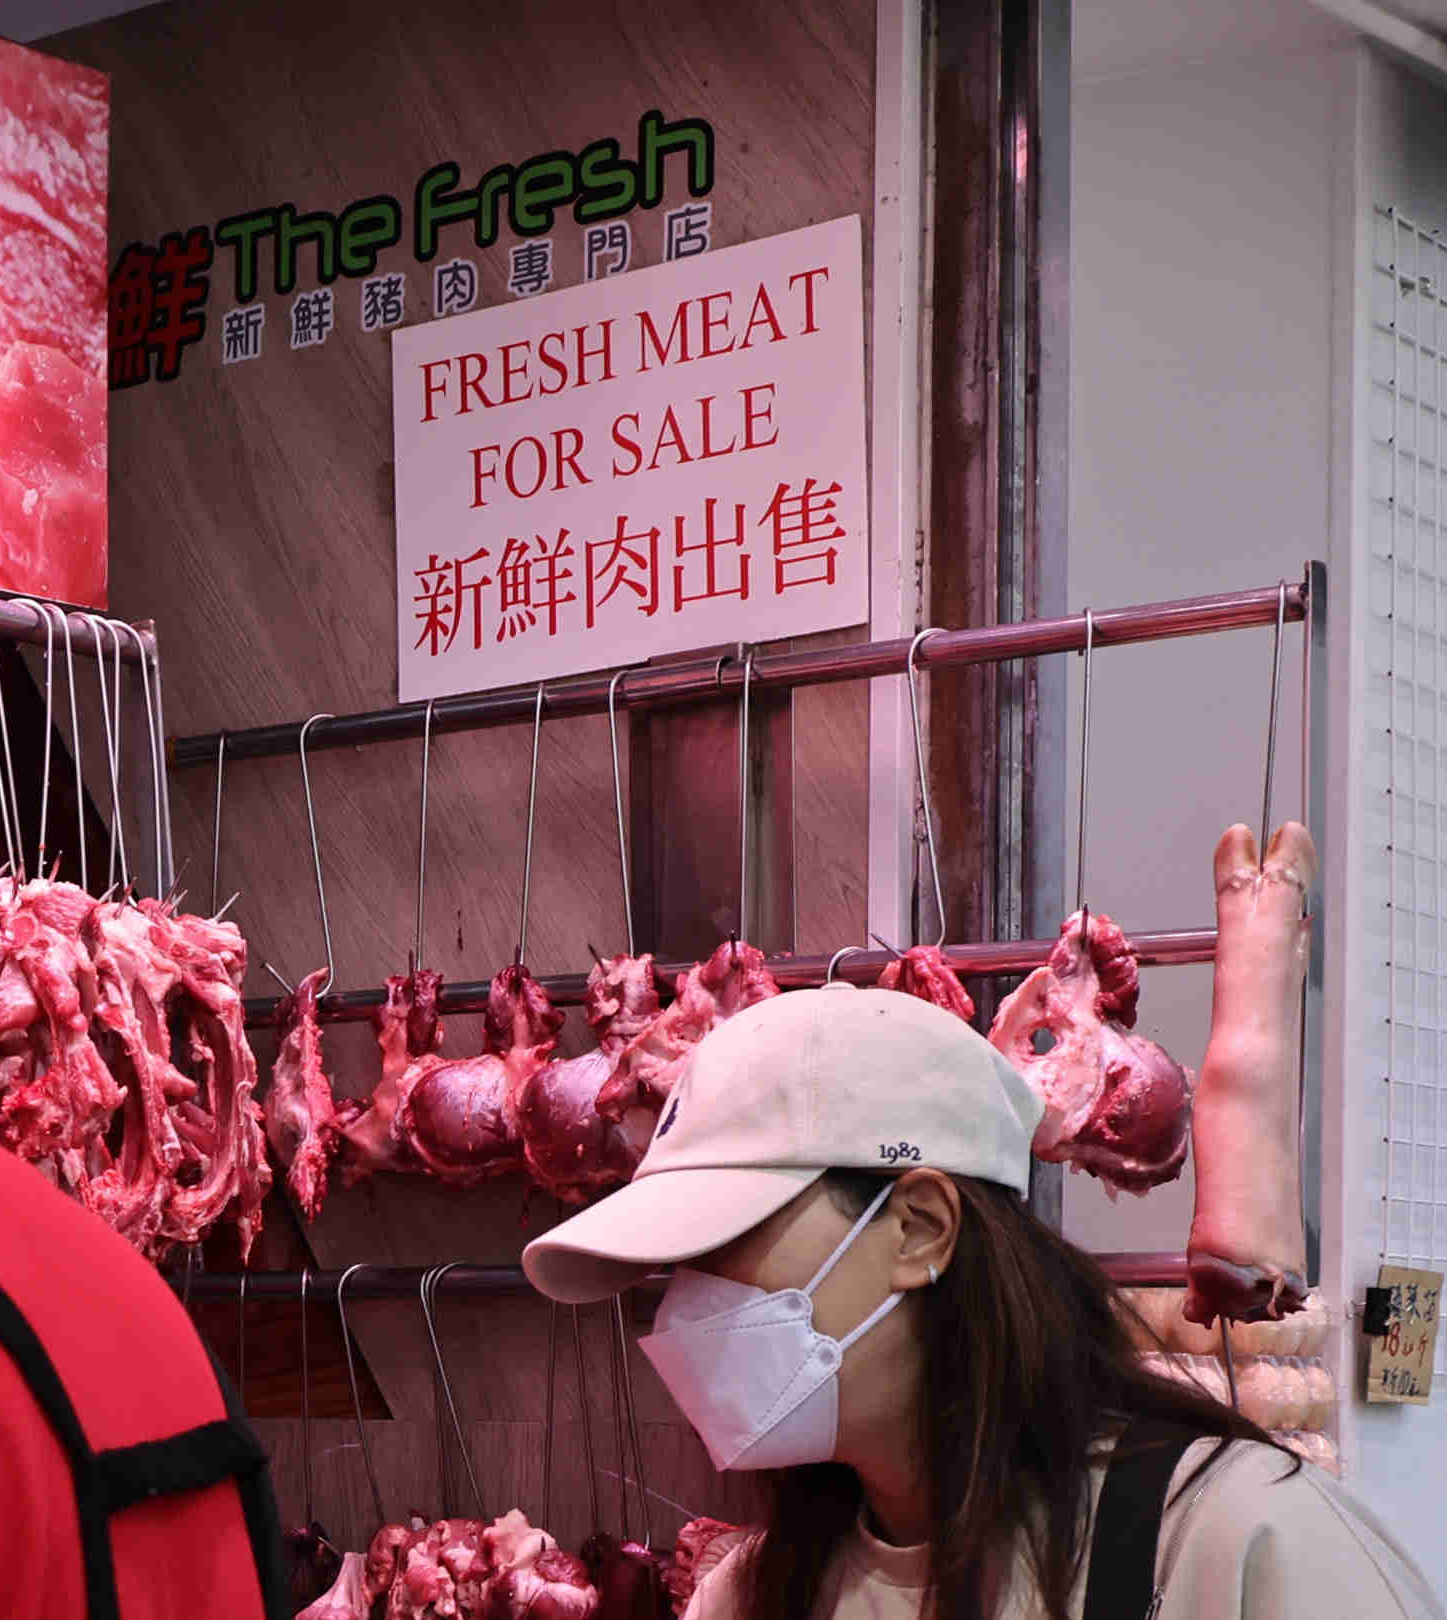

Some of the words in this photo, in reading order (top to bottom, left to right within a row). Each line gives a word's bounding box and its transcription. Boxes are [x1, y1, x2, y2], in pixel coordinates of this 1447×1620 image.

[217, 205, 402, 304] The
[222, 203, 713, 365] 新鮮豬肉專門店
[419, 325, 615, 424] FRESH
[636, 266, 831, 374] MEAT
[468, 427, 591, 508] FOR
[610, 383, 781, 480] SALE
[412, 477, 848, 657] 新鮮肉出售
[879, 1142, 922, 1164] 1982
